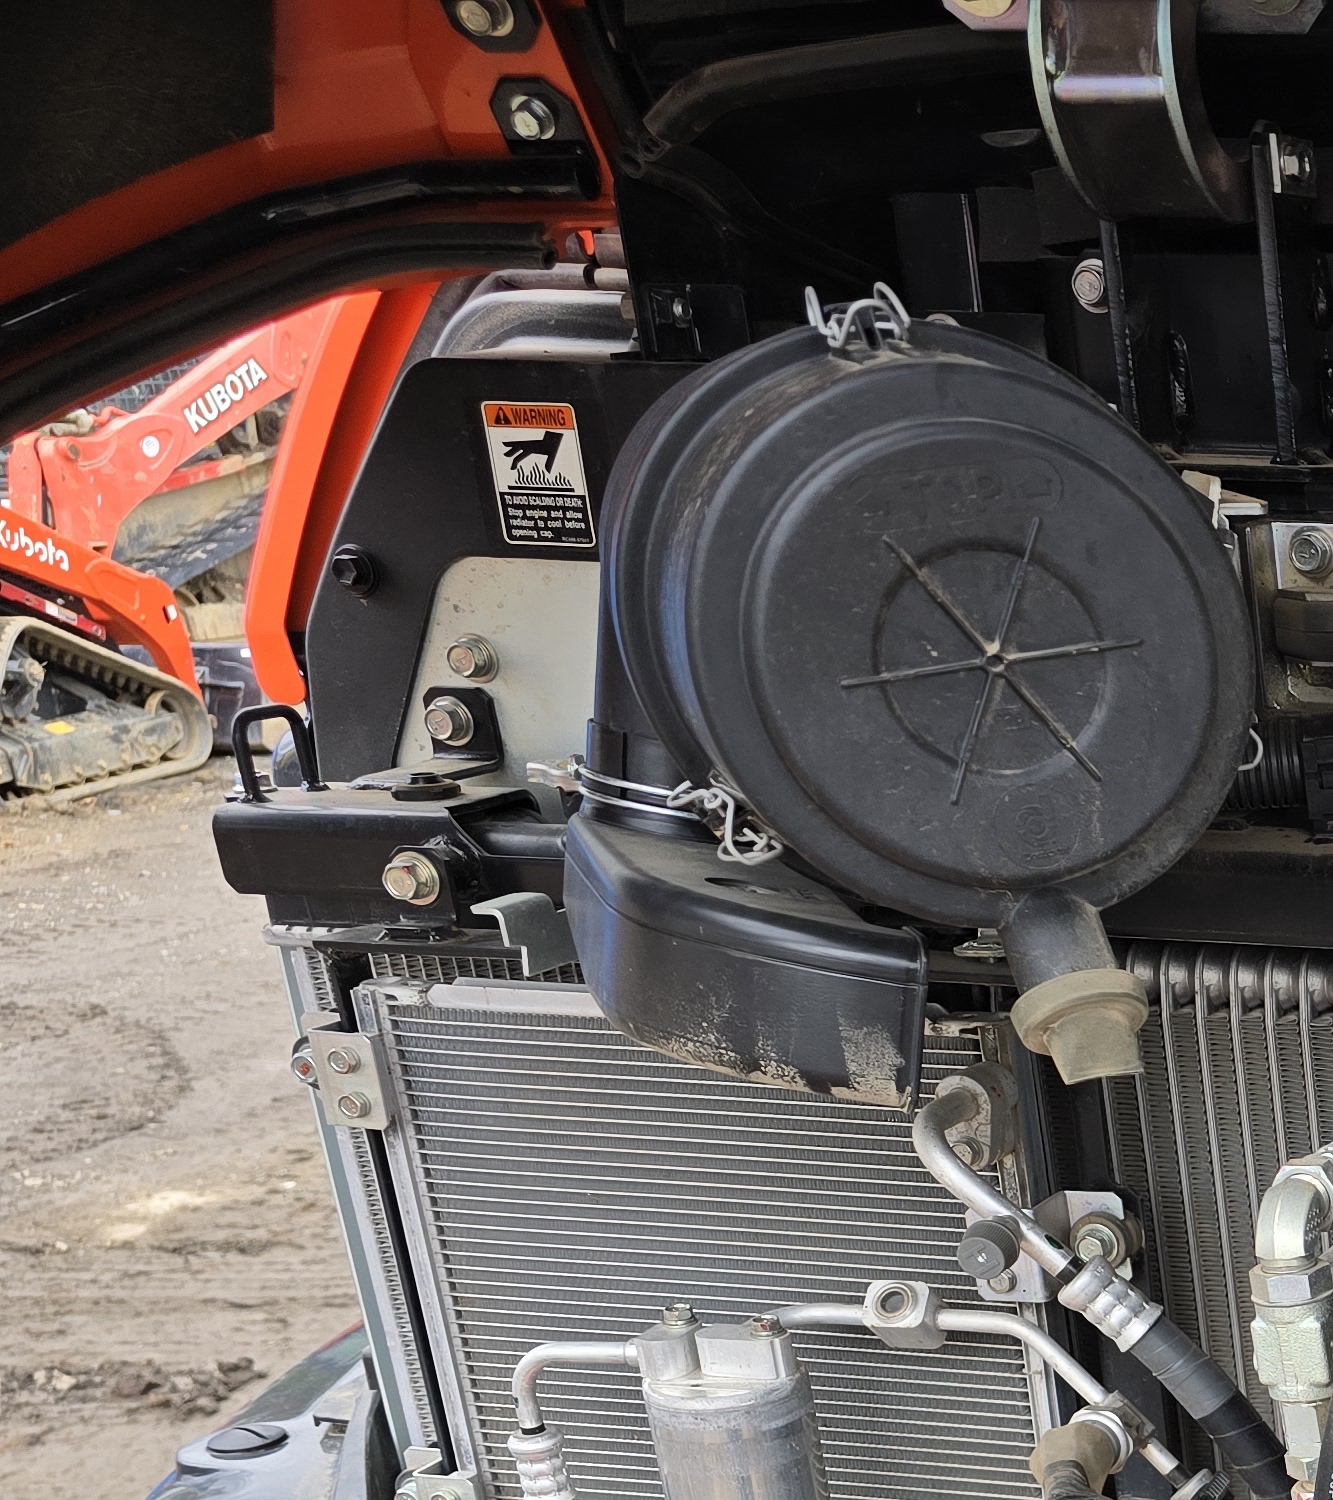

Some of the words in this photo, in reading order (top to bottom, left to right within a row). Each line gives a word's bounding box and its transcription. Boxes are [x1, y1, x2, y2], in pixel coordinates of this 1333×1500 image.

[183, 358, 268, 434] KUBOTA
[510, 407, 566, 426] WARNING
[508, 508, 524, 518] Stop
[526, 509, 548, 519] engine
[550, 508, 563, 518] and
[565, 510, 583, 519] allow
[510, 518, 535, 527] radiator
[537, 518, 545, 527] to
[547, 519, 562, 528] cool
[564, 520, 586, 529] before
[511, 528, 538, 538] opening
